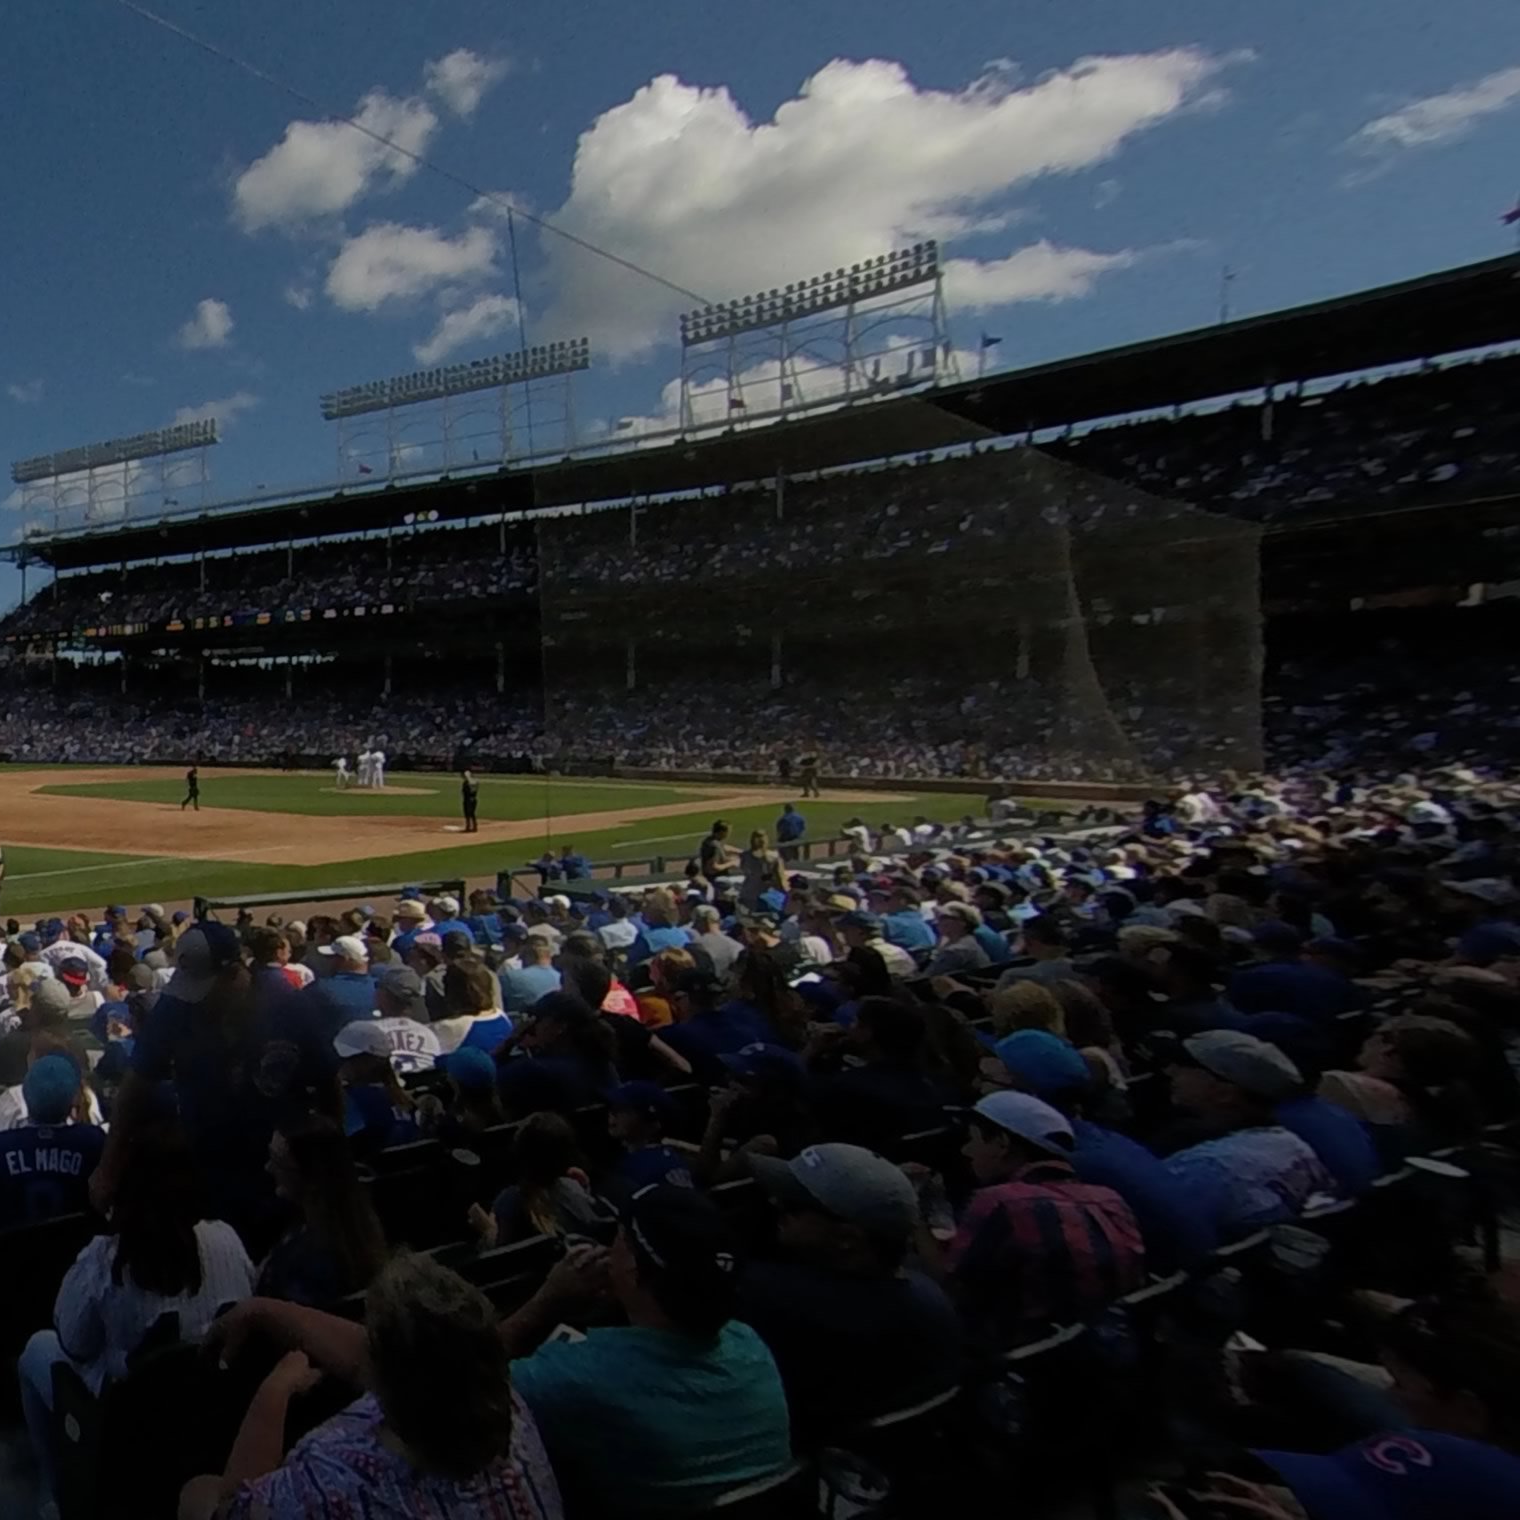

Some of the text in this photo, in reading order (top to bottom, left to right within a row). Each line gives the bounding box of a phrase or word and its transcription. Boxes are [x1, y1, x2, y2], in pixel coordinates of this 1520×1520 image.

[5, 1147, 83, 1177] EL MAGO
[1361, 1435, 1434, 1476] C
